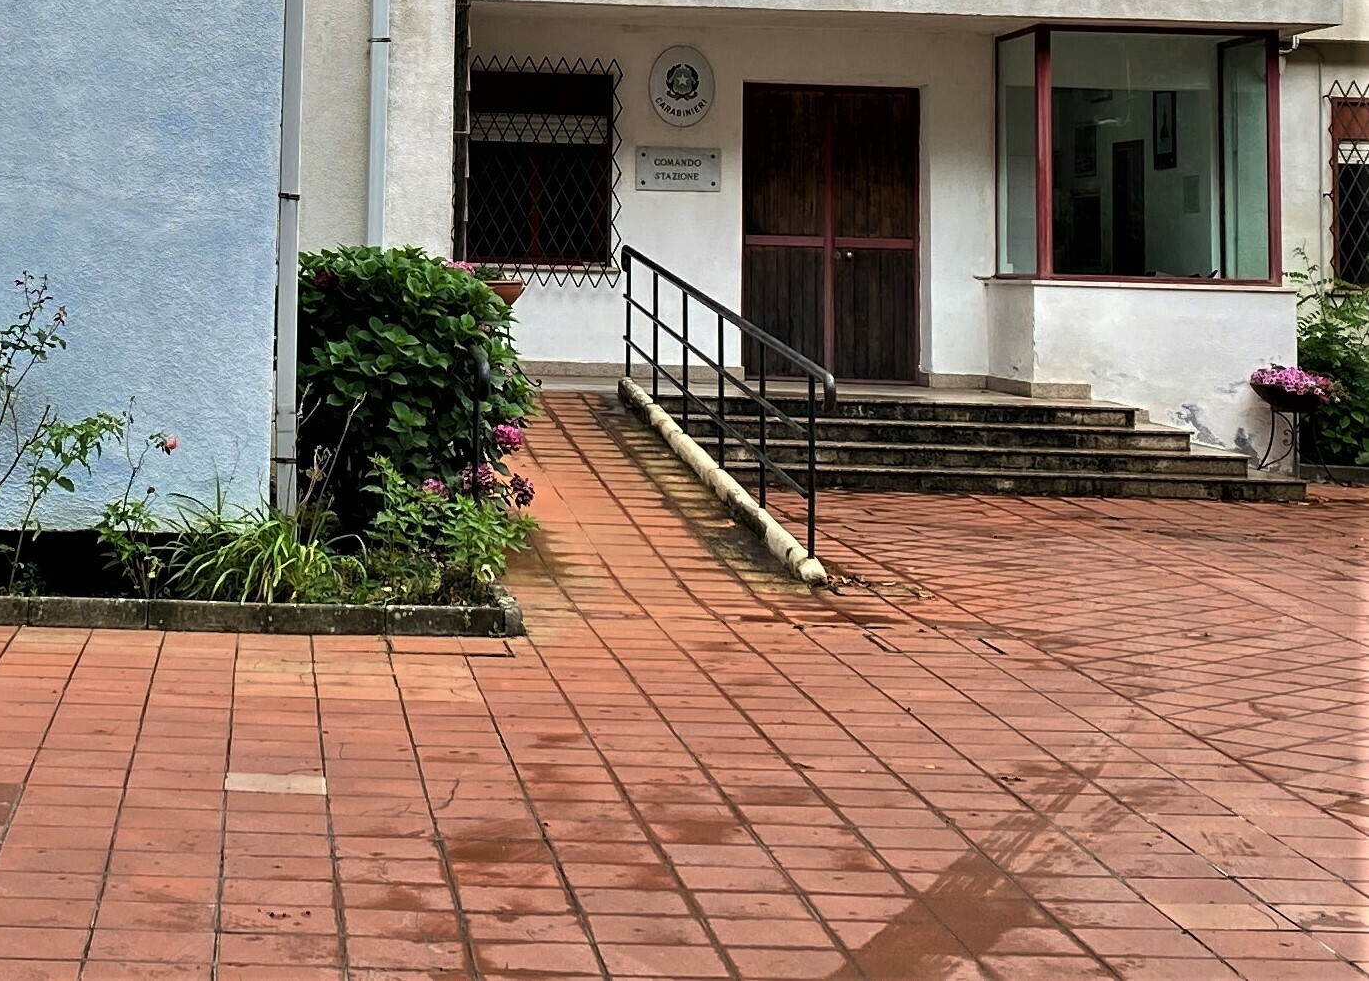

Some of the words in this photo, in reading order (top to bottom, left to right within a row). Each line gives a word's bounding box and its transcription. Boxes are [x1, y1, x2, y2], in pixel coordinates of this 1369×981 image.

[654, 96, 708, 117] CARABINIERI
[653, 158, 702, 168] COMANDO
[654, 172, 700, 181] STAZIONE
